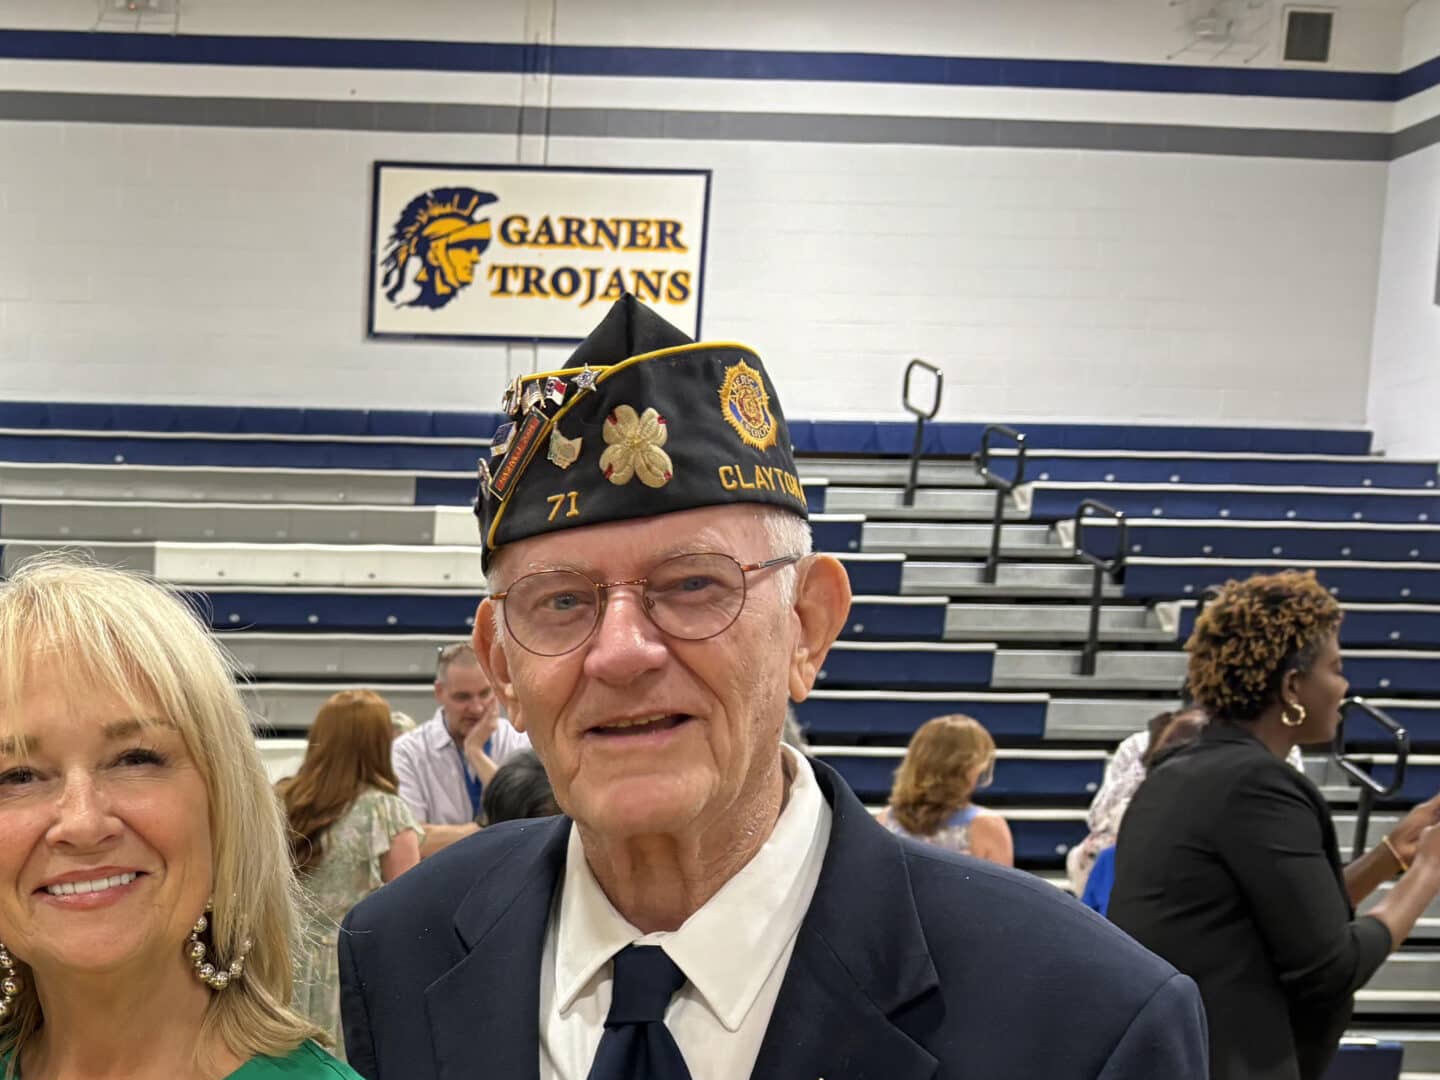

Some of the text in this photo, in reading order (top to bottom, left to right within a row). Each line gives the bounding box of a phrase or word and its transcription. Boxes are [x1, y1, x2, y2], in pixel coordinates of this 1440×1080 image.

[497, 215, 689, 252] GARNER
[487, 264, 692, 307] TROJANS
[546, 491, 579, 522] 71
